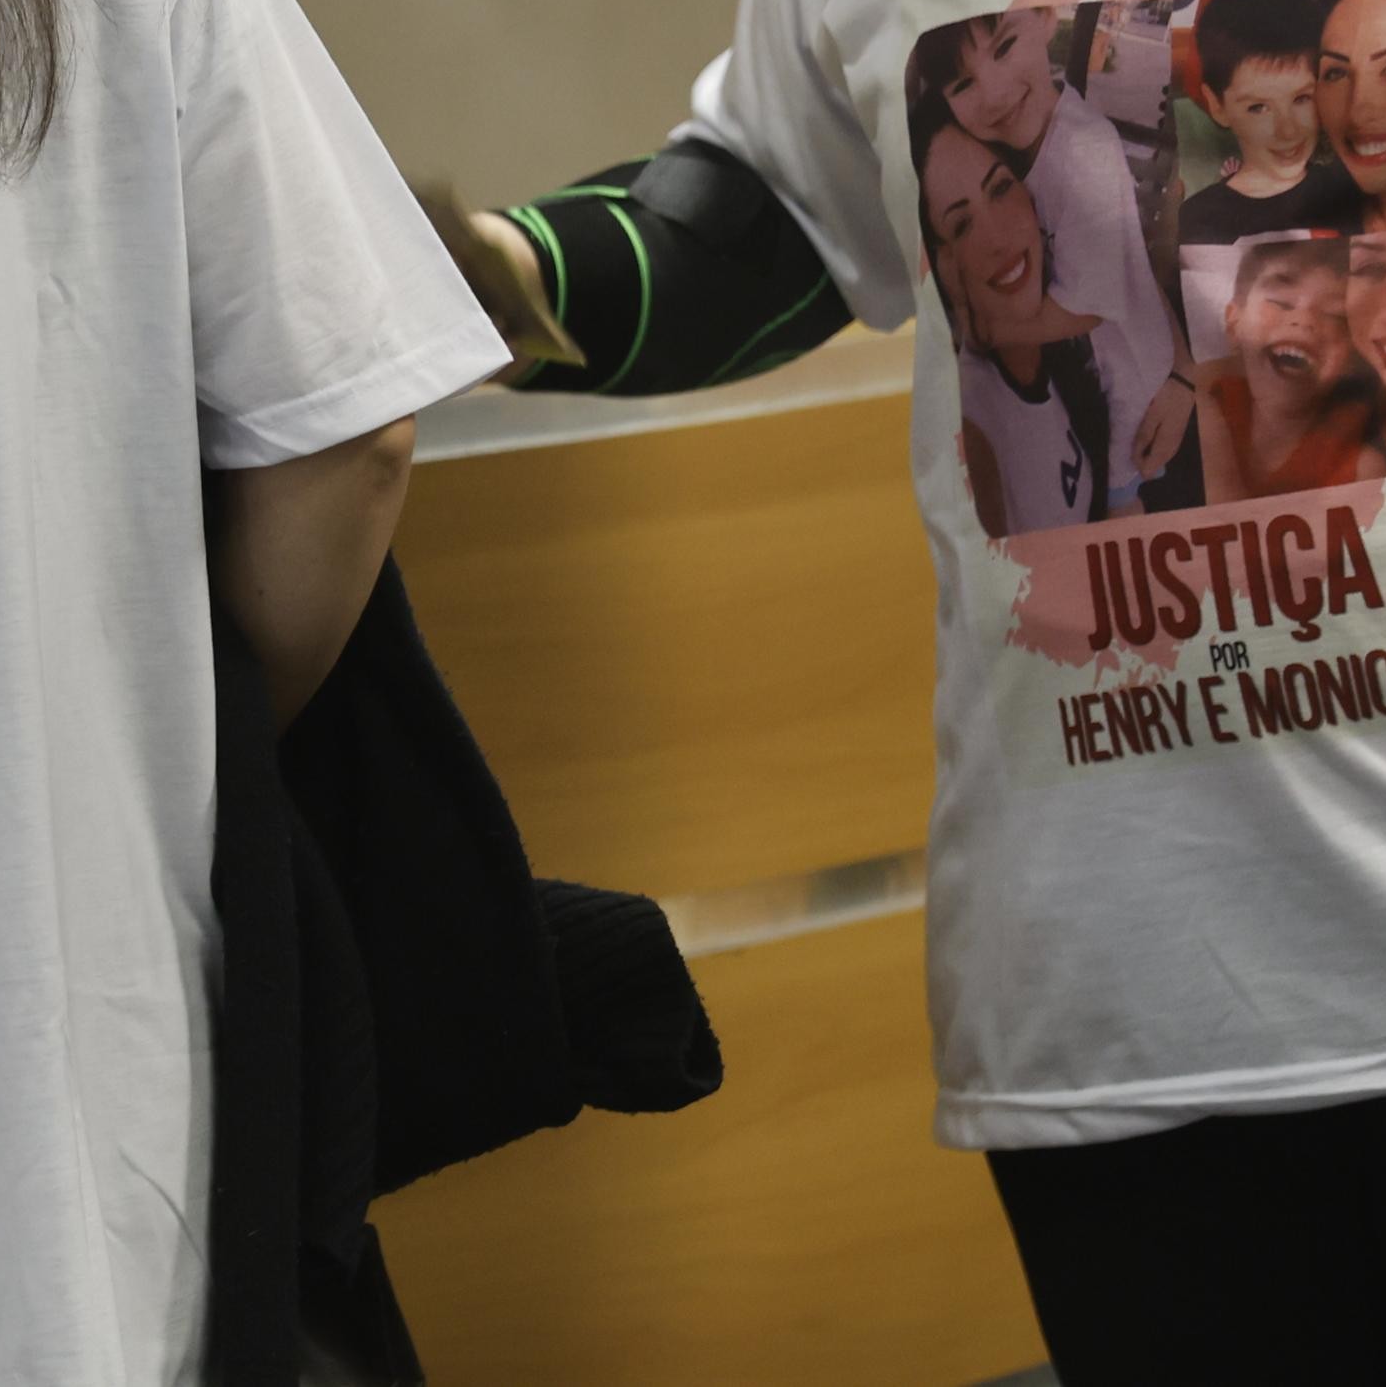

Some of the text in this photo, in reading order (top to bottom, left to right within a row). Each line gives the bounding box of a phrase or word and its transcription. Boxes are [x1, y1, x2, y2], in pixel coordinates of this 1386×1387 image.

[1085, 505, 1385, 651] JUSTIÇA
[1211, 641, 1250, 672] POR
[1058, 681, 1194, 765] HENRY
[1198, 676, 1239, 742] E
